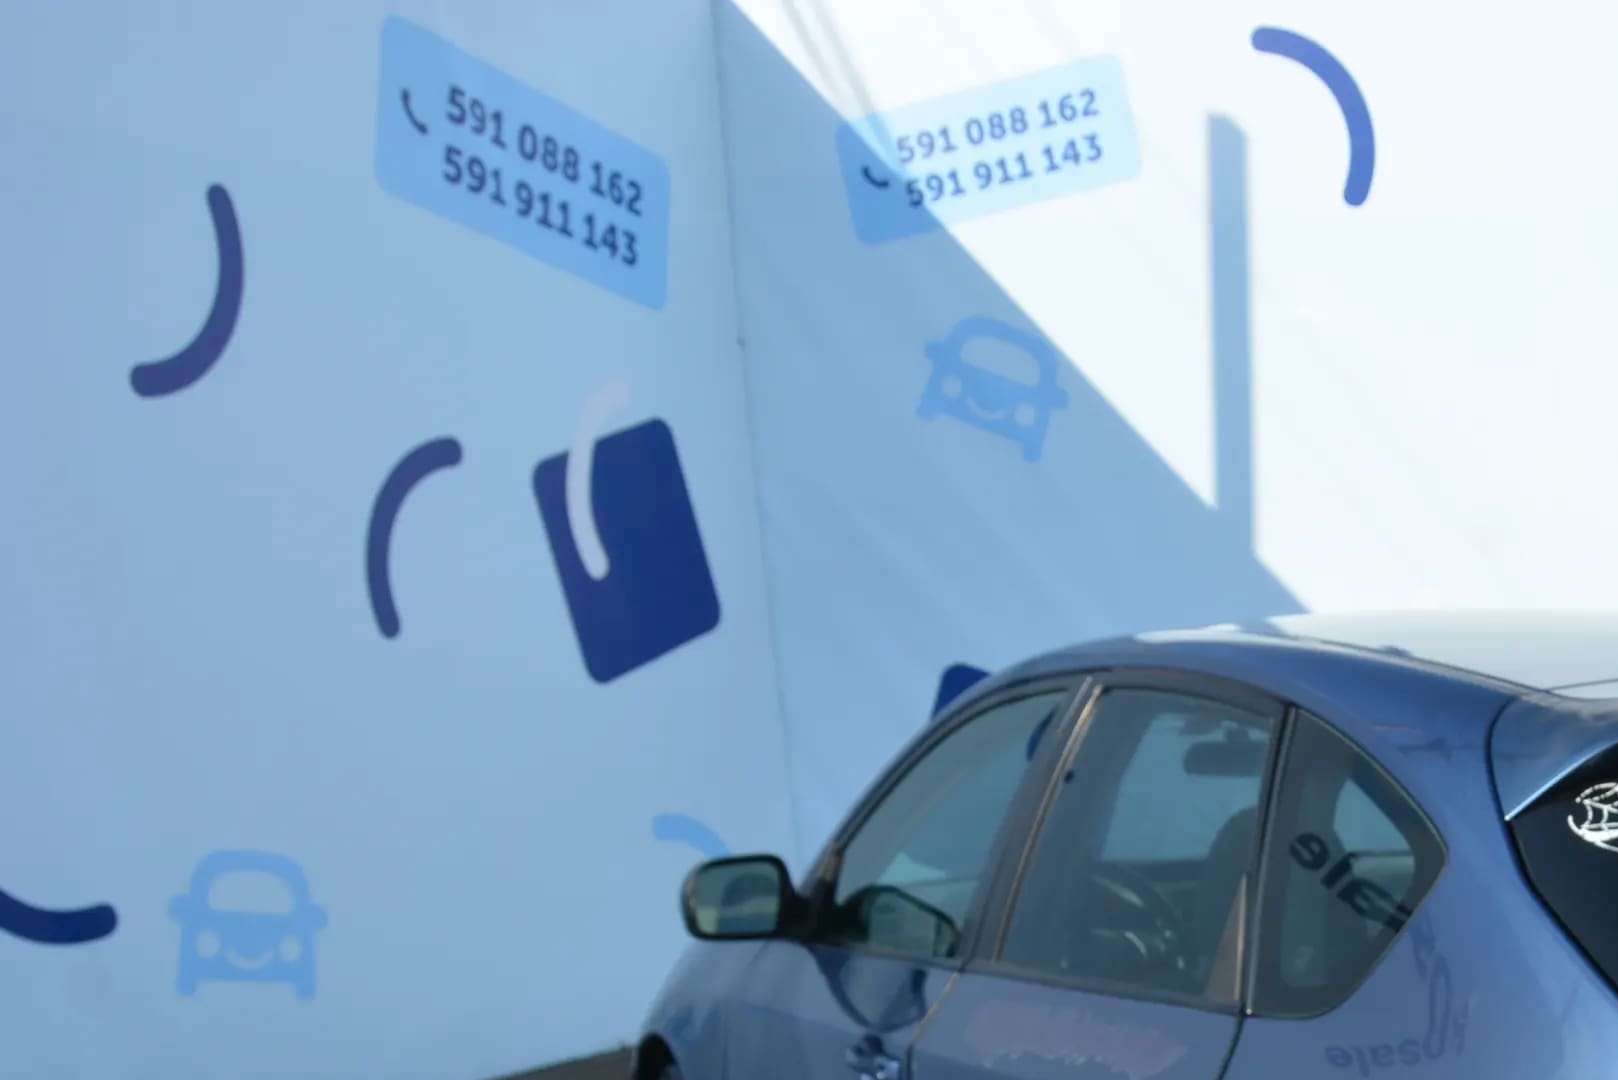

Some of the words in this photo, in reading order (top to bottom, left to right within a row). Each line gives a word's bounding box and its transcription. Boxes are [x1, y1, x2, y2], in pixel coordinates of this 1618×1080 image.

[446, 84, 507, 149] 591
[517, 123, 580, 183] 088
[589, 160, 642, 217] 162
[896, 125, 957, 164] 591
[965, 105, 1029, 146] 088
[1038, 88, 1100, 128] 162
[905, 169, 966, 208] 591
[974, 152, 1034, 190] 911
[1042, 133, 1103, 173] 143
[443, 143, 506, 206] 591
[514, 180, 573, 238] 911
[582, 213, 638, 267] 143
